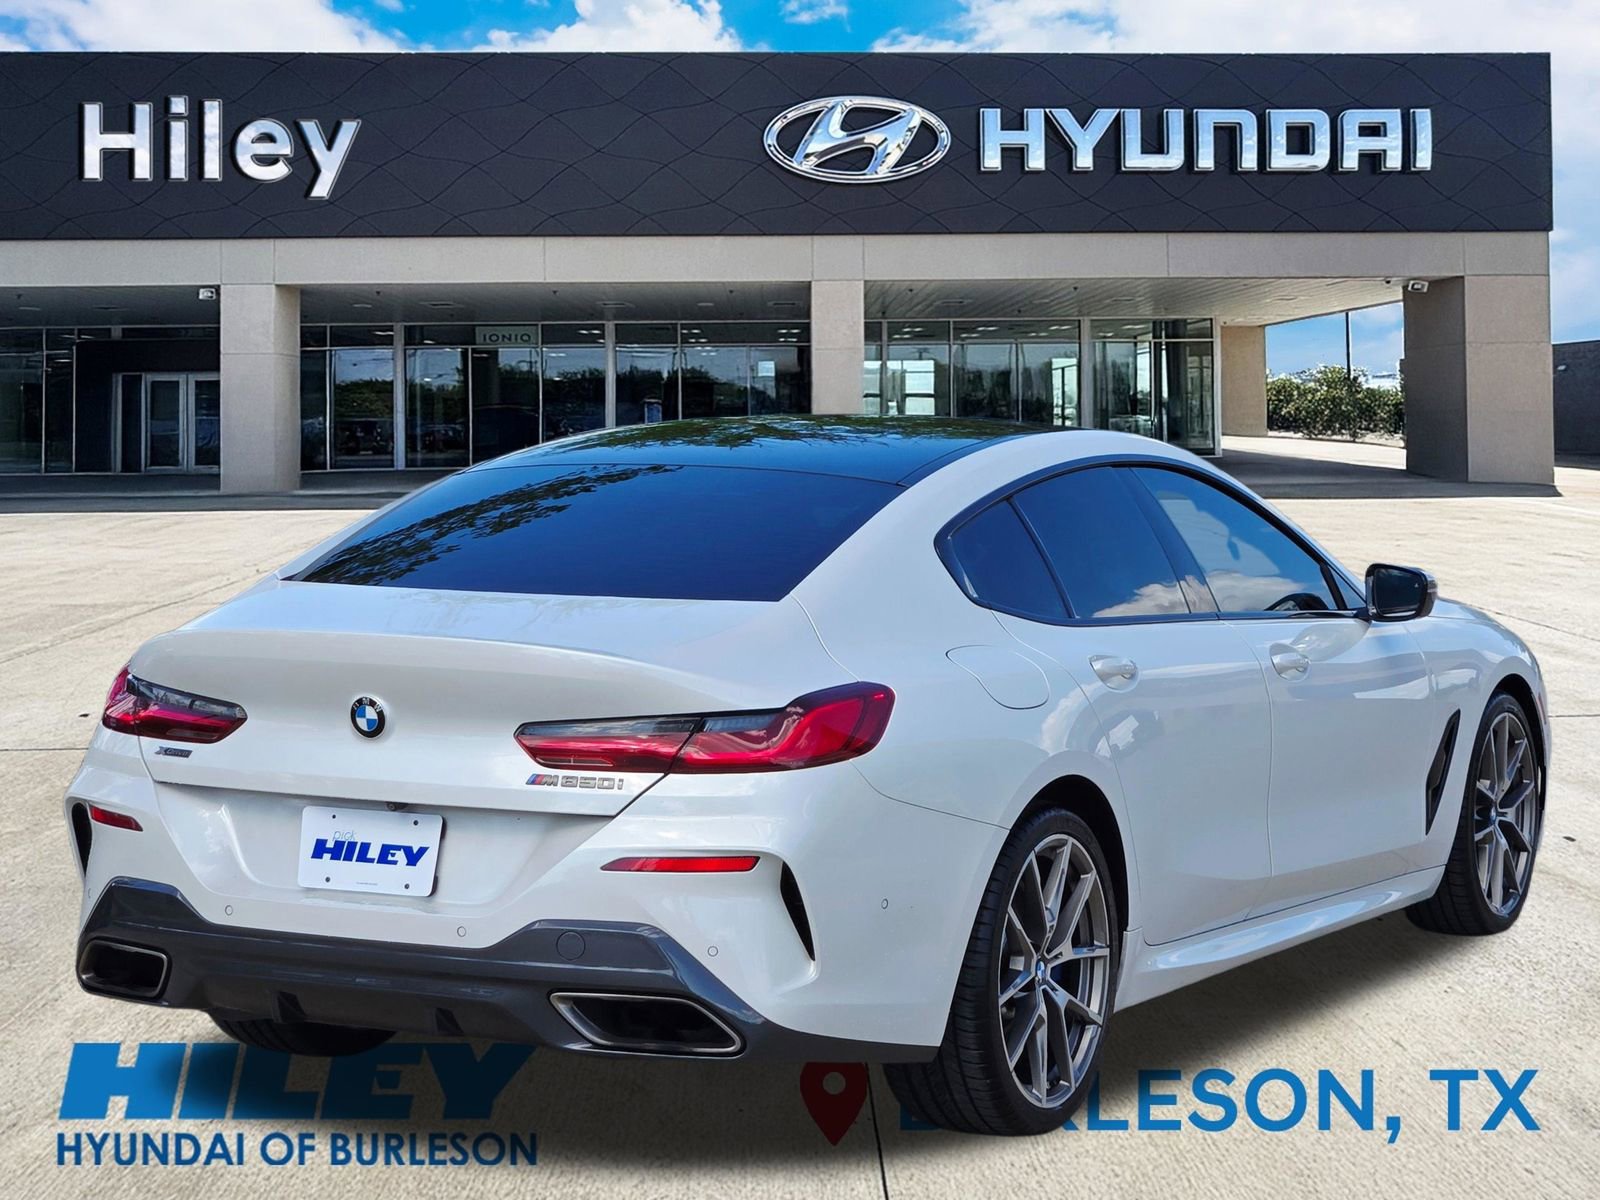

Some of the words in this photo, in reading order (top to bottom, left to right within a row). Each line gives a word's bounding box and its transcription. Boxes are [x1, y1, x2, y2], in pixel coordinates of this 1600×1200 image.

[80, 94, 362, 200] Hiley
[979, 107, 1433, 173] HYUNDAI
[352, 697, 382, 712] BMW
[311, 838, 430, 867] HILEY
